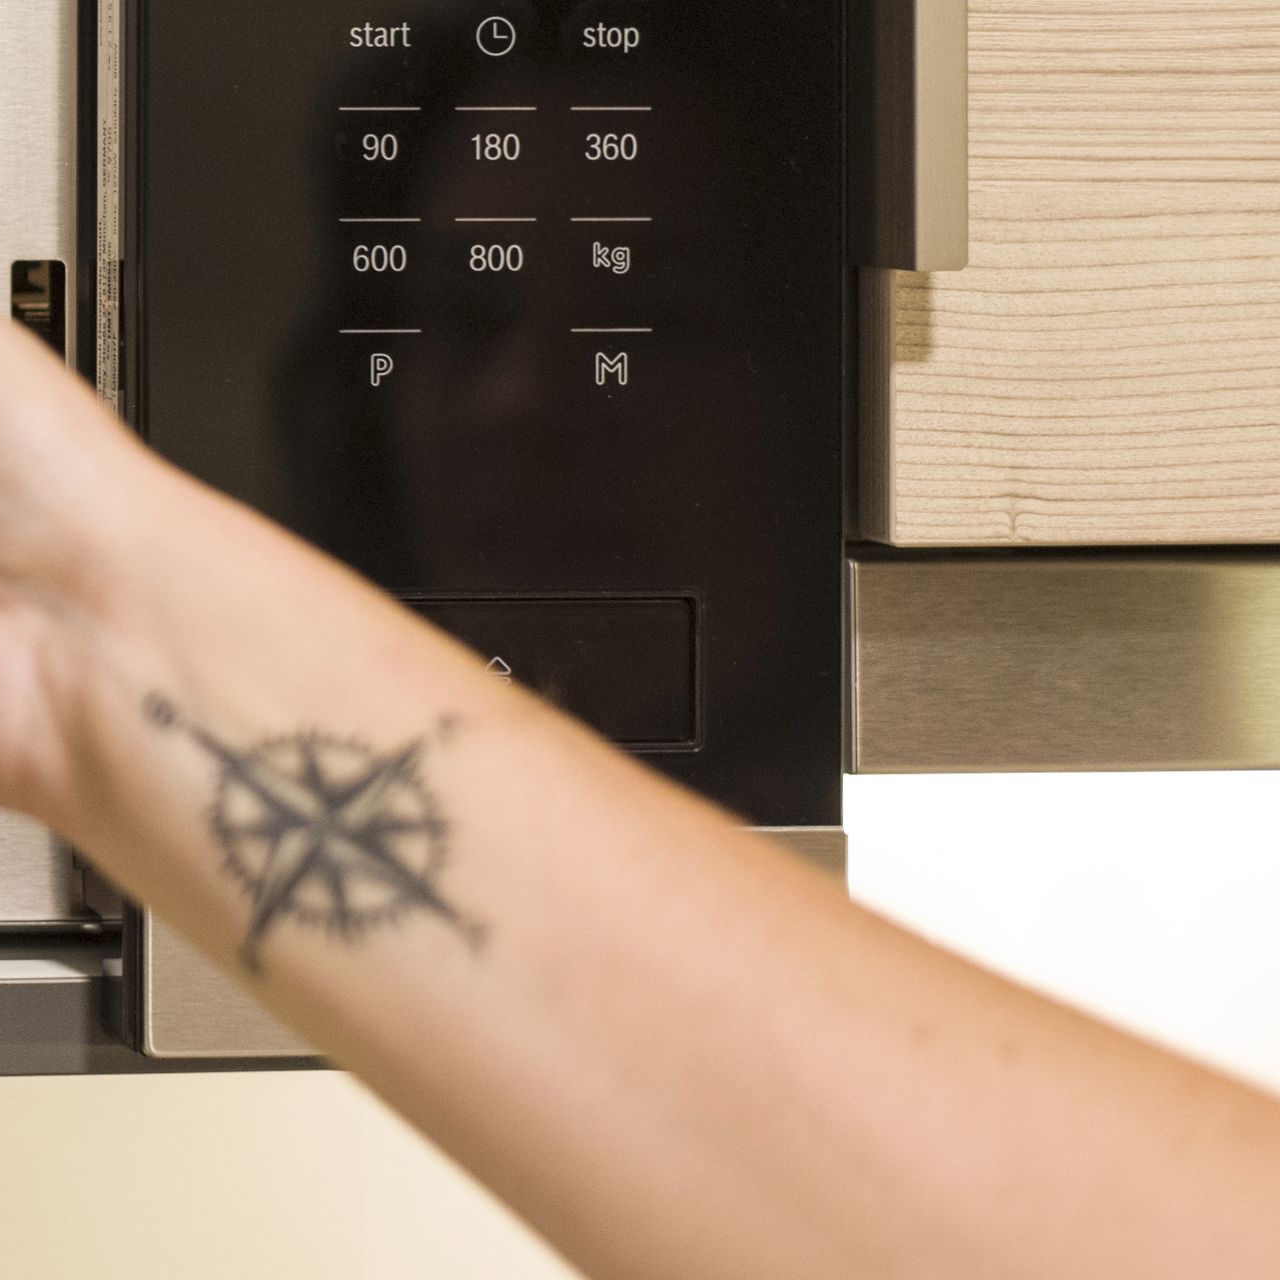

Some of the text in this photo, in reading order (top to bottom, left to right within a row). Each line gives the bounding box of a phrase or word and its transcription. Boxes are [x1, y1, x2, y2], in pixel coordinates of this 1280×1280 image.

[349, 21, 411, 48] start
[583, 21, 640, 53] stop
[362, 133, 398, 161] 90
[471, 133, 520, 161] 180
[584, 133, 638, 161] 360
[352, 244, 407, 272] 600
[469, 244, 524, 272] 800
[592, 242, 631, 274] kg
[369, 352, 394, 387] P
[595, 352, 628, 386] M
